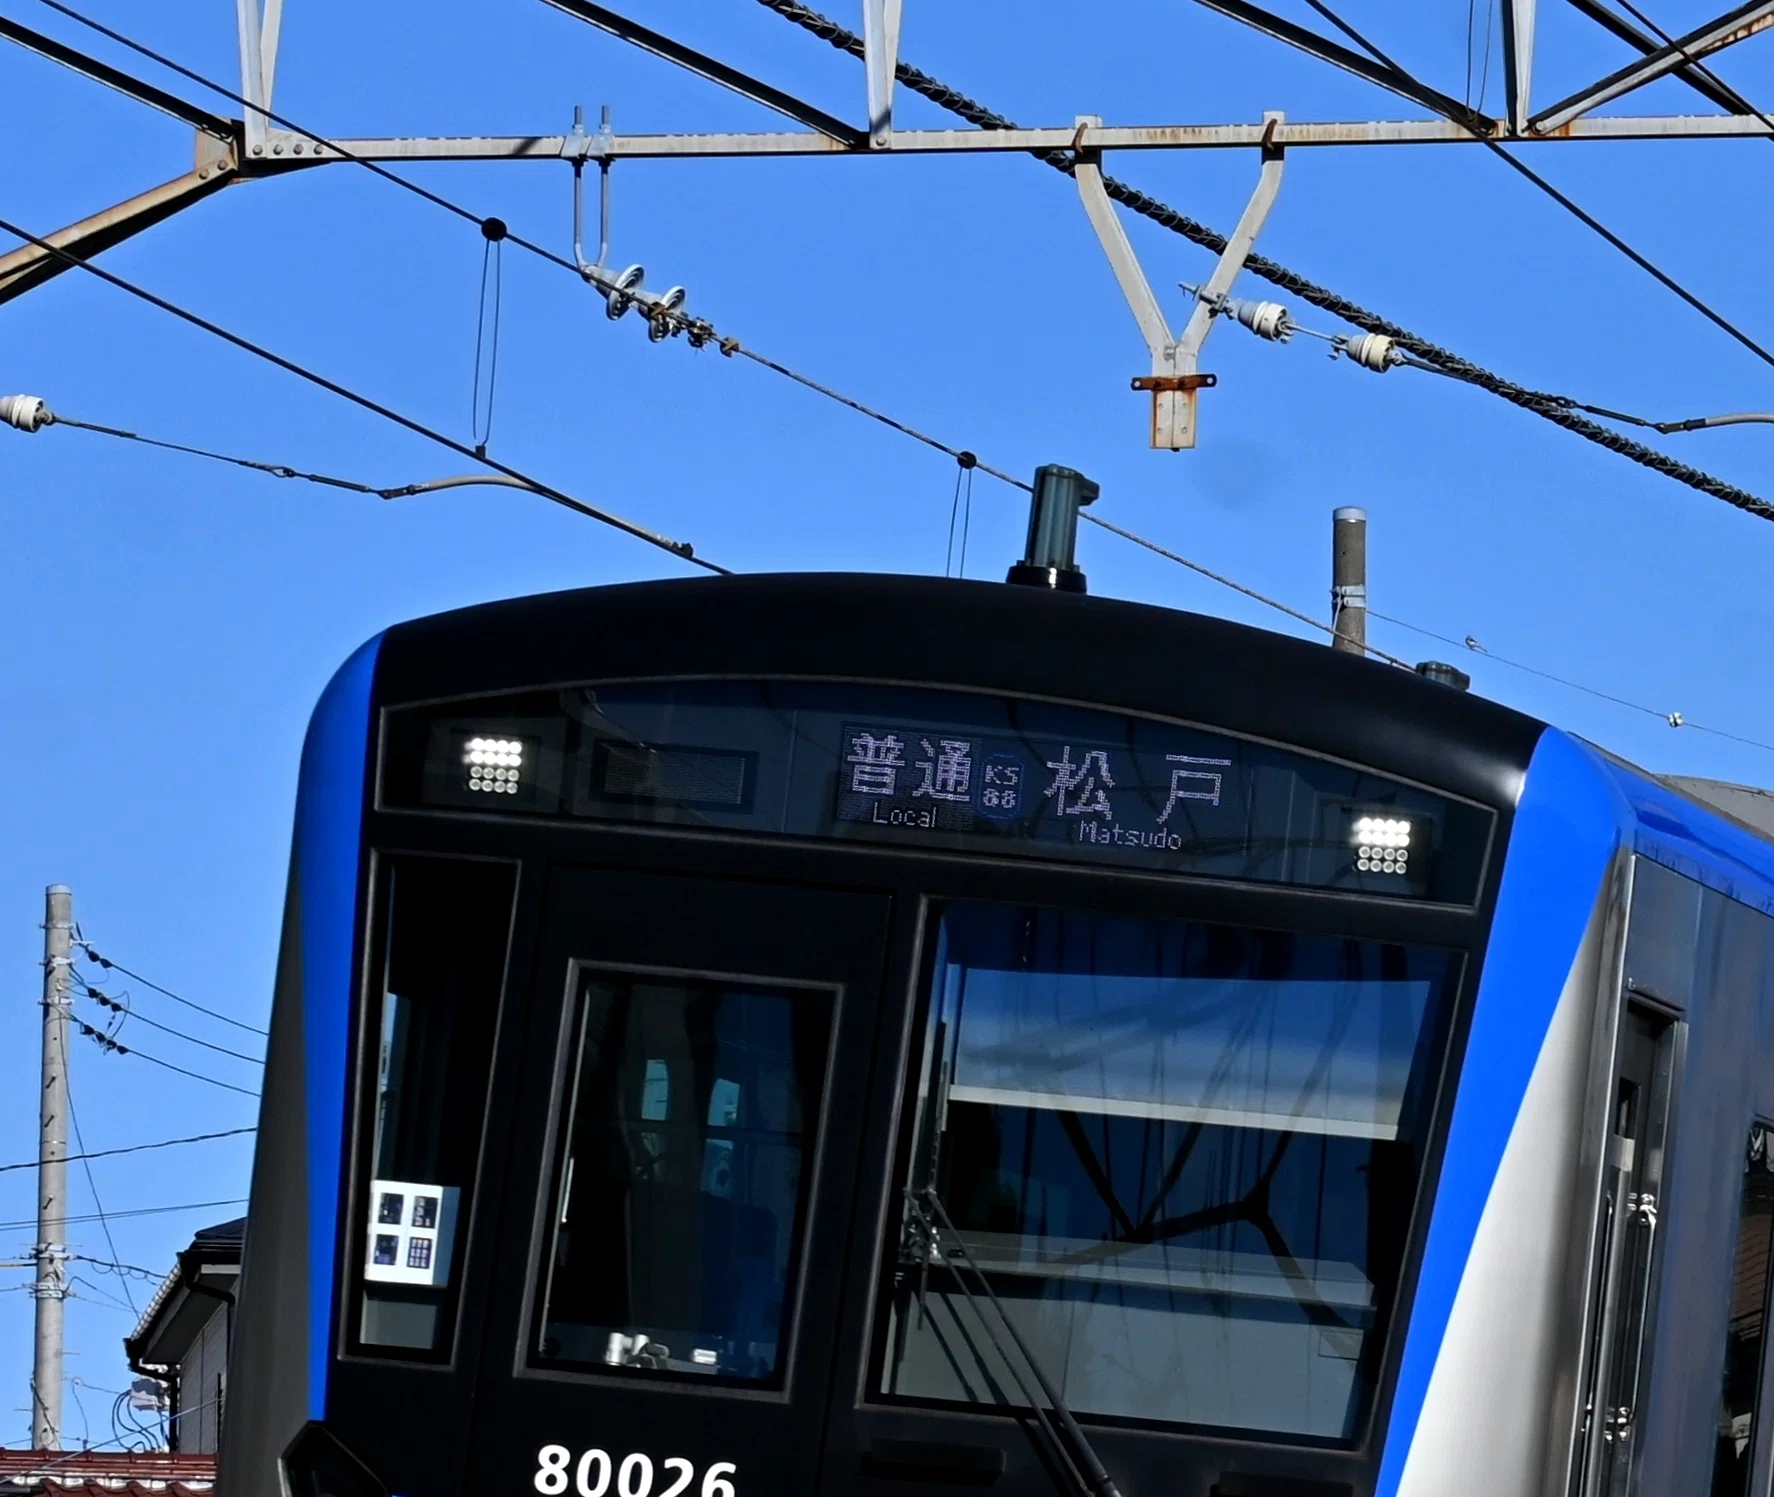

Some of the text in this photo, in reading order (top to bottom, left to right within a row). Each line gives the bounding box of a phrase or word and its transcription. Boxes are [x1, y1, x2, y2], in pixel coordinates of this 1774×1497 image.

[847, 733, 971, 801] 普通
[984, 765, 1019, 785] KS
[1043, 746, 1232, 824] 松戸
[872, 802, 938, 828] Local
[1079, 820, 1183, 850] Matsudo
